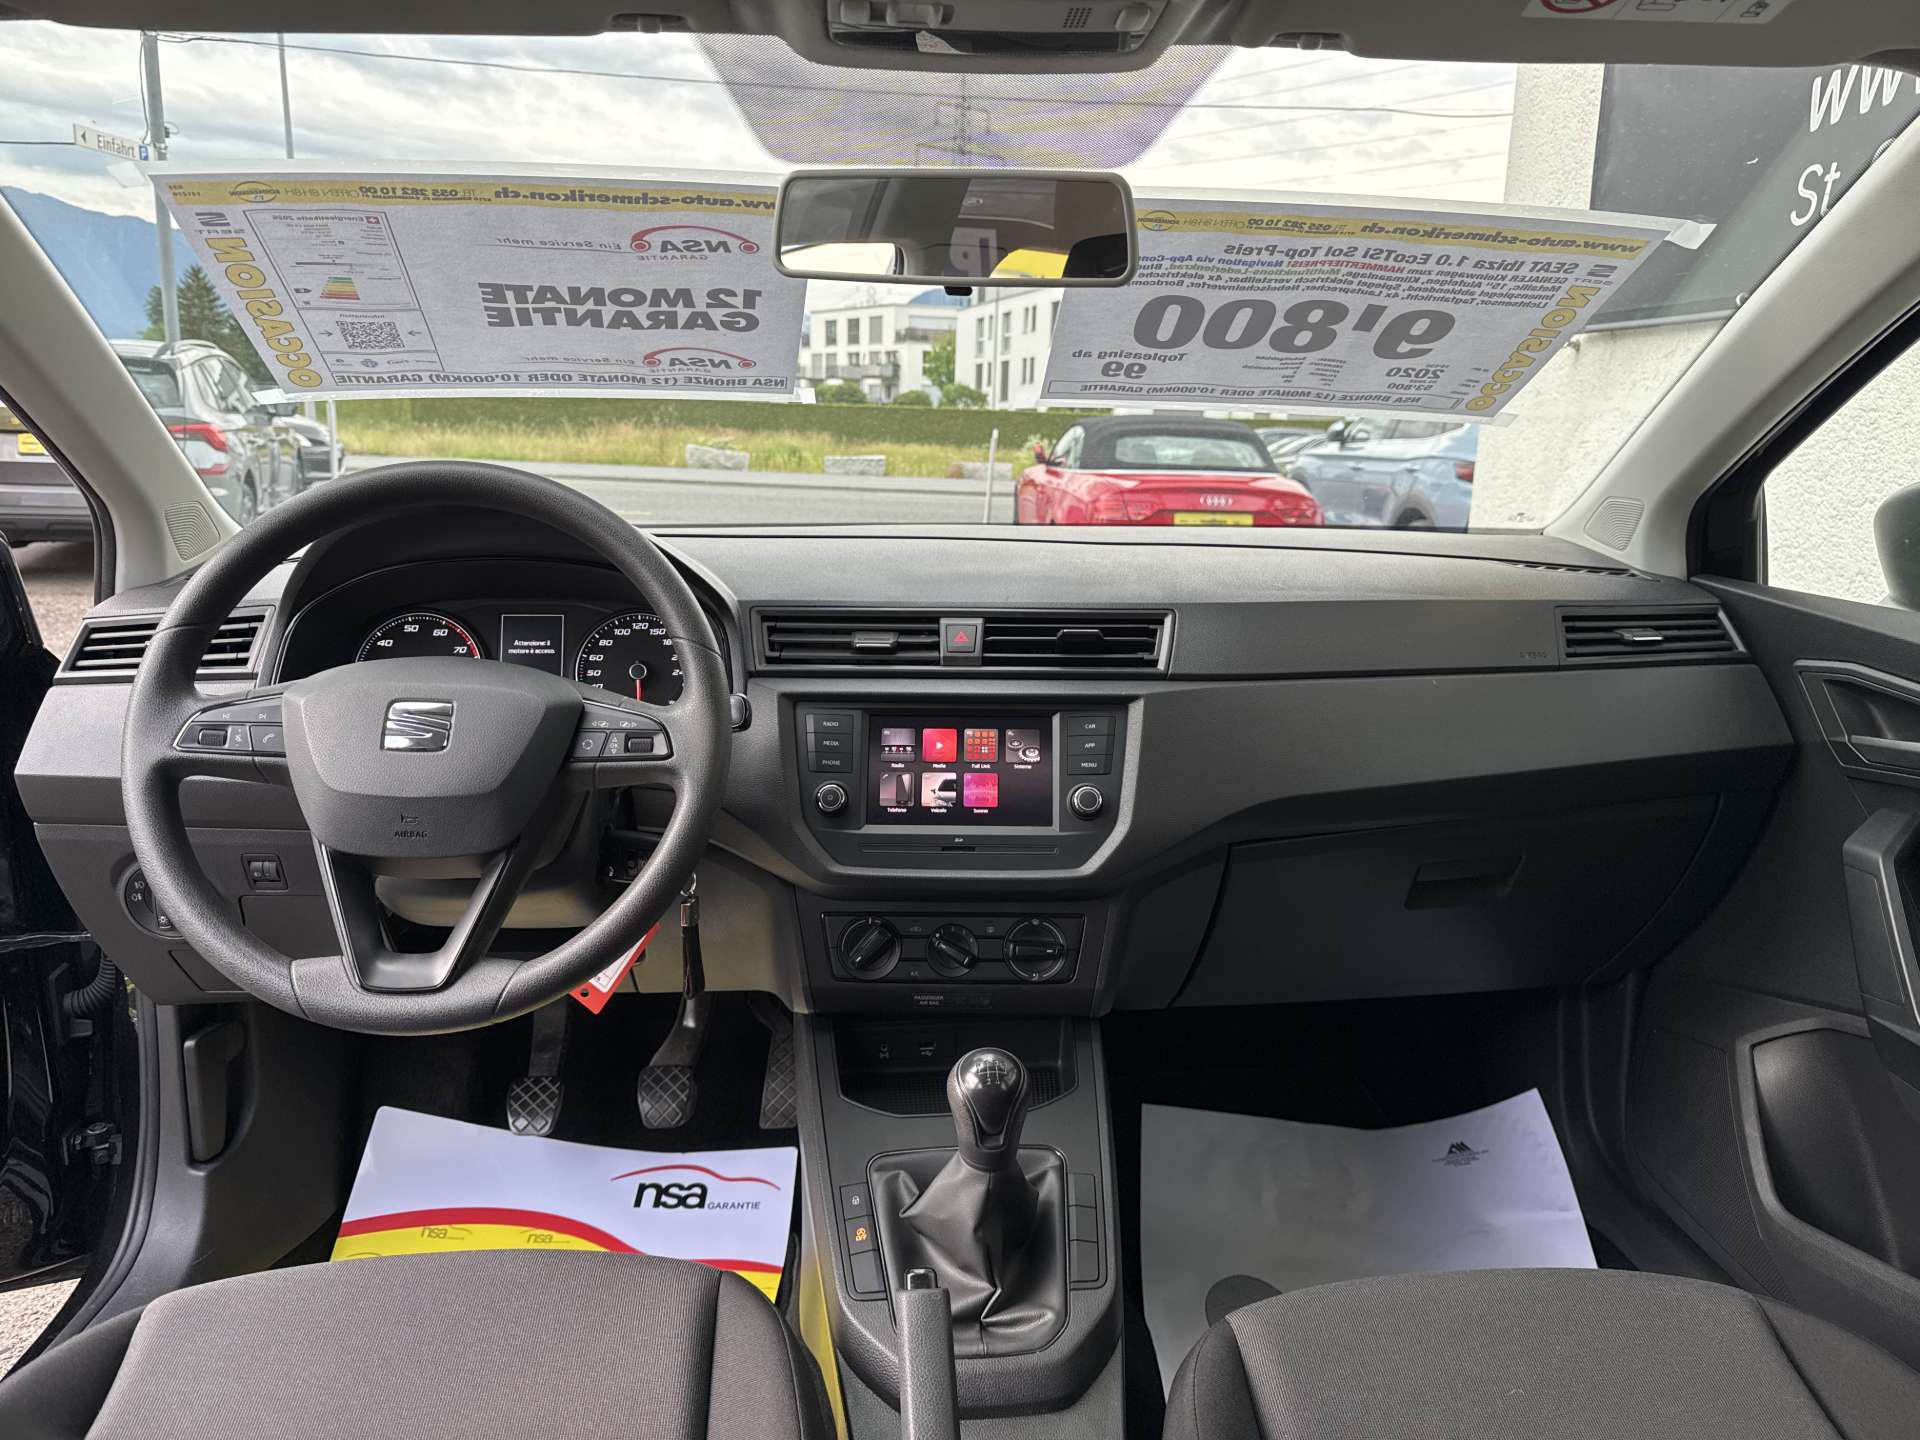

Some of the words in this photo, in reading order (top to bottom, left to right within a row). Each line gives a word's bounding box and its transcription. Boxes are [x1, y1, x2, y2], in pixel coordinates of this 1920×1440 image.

[97, 134, 136, 158] Einfahrt
[403, 624, 420, 633] 50
[632, 622, 649, 630] 120
[432, 629, 449, 637] 60
[614, 628, 631, 636] 100
[649, 628, 667, 636] 150
[377, 639, 394, 647] 40
[598, 639, 614, 647] 80
[453, 646, 468, 654] 70
[586, 669, 602, 677] 50
[394, 830, 429, 838] AIRBAG
[633, 1182, 708, 1210] nsa
[707, 1202, 761, 1210] GARANTIE
[420, 1227, 448, 1240] nsa
[527, 1233, 553, 1244] nsa
